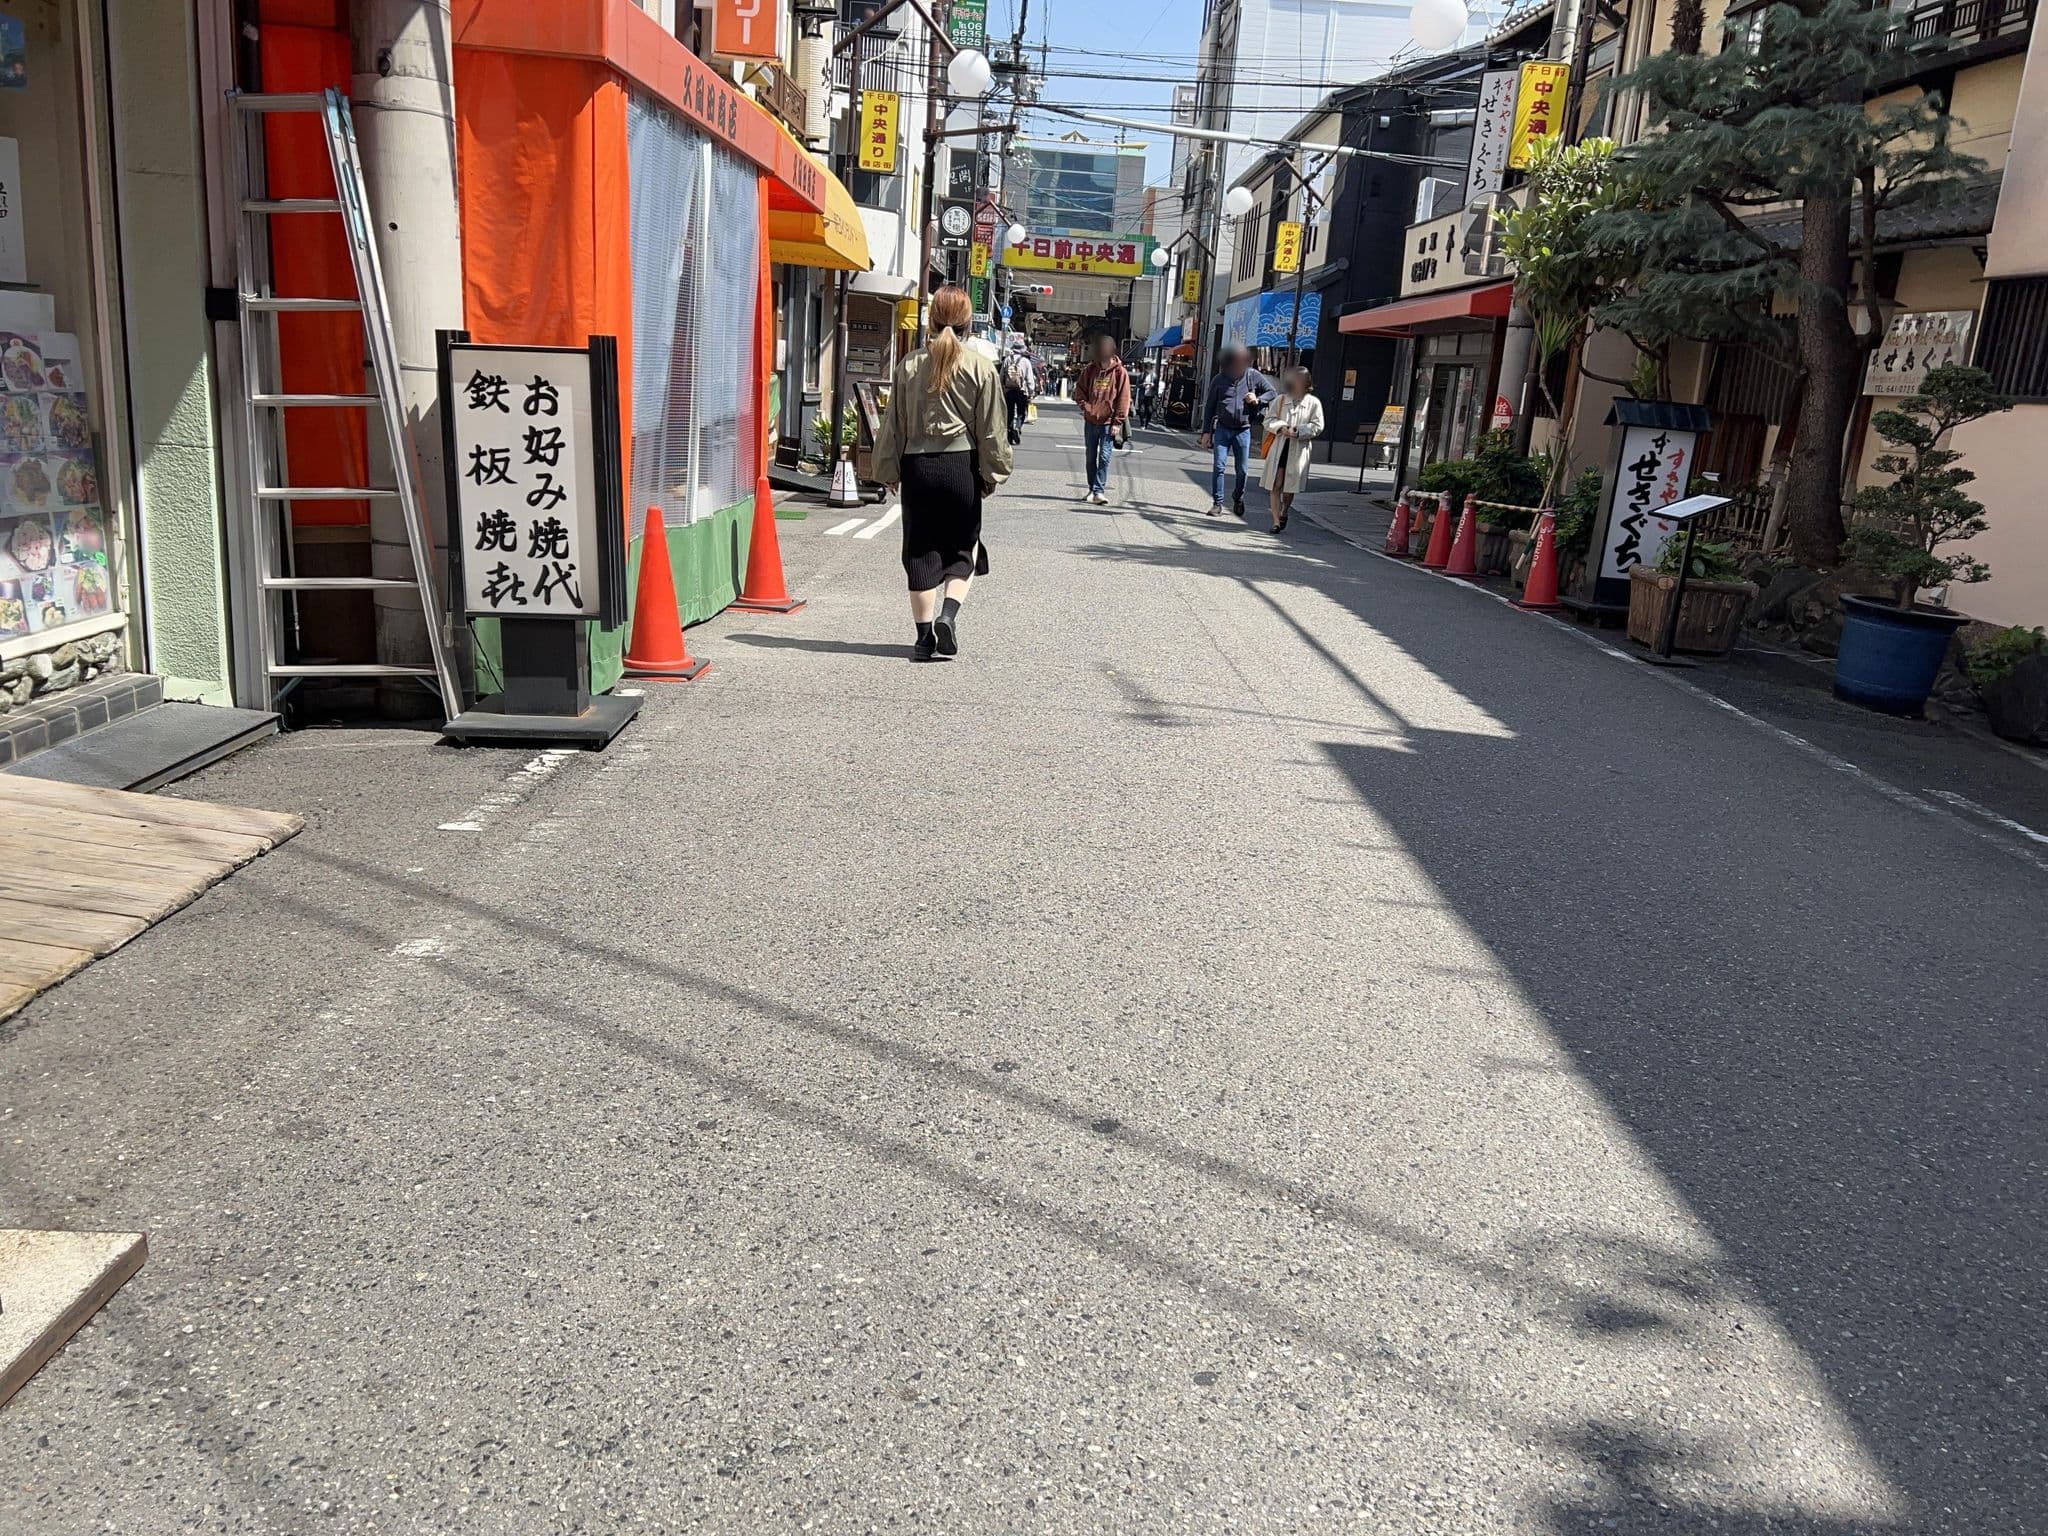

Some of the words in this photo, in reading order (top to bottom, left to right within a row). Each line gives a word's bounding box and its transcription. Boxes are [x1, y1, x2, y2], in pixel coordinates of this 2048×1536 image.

[952, 28, 982, 38] 6635
[967, 22, 982, 30] 06
[952, 37, 981, 46] 2525
[1527, 65, 1566, 77] 千日前
[866, 92, 896, 102] 千日前
[1498, 76, 1514, 138] すきやき
[1527, 80, 1553, 144] 中央通
[871, 104, 888, 158] 中央通り
[1012, 237, 1136, 265] 千日前中央通
[1283, 230, 1294, 264] 中央通り
